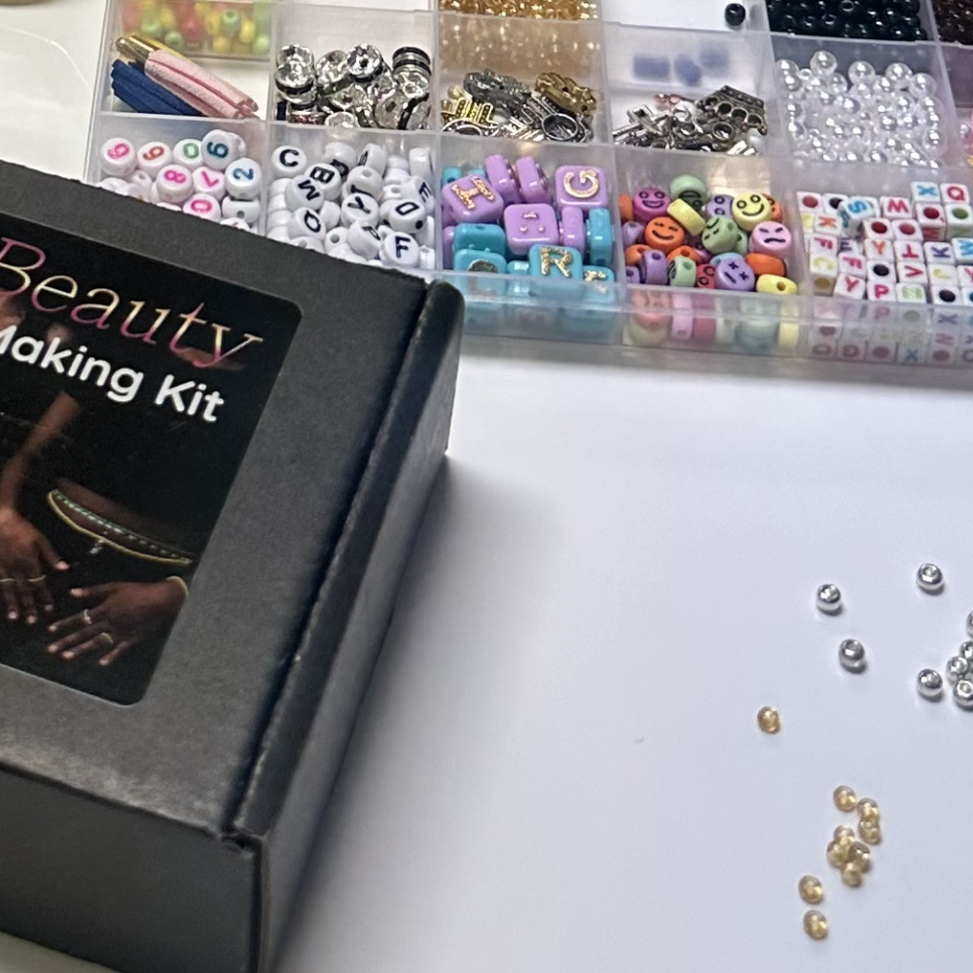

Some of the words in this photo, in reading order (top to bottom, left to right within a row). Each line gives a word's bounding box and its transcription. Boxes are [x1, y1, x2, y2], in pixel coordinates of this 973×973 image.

[279, 148, 300, 167] C
[309, 166, 335, 184] B
[562, 169, 600, 199] G
[451, 175, 496, 210] H
[946, 186, 965, 202] Q
[347, 196, 371, 214] Y
[847, 199, 868, 214] S
[395, 235, 411, 259] F
[871, 240, 887, 256] Y
[901, 243, 920, 259] T
[930, 245, 952, 259] K
[540, 245, 574, 278] R
[844, 276, 860, 293] Y
[873, 283, 890, 299] P
[154, 374, 226, 424] Kit
